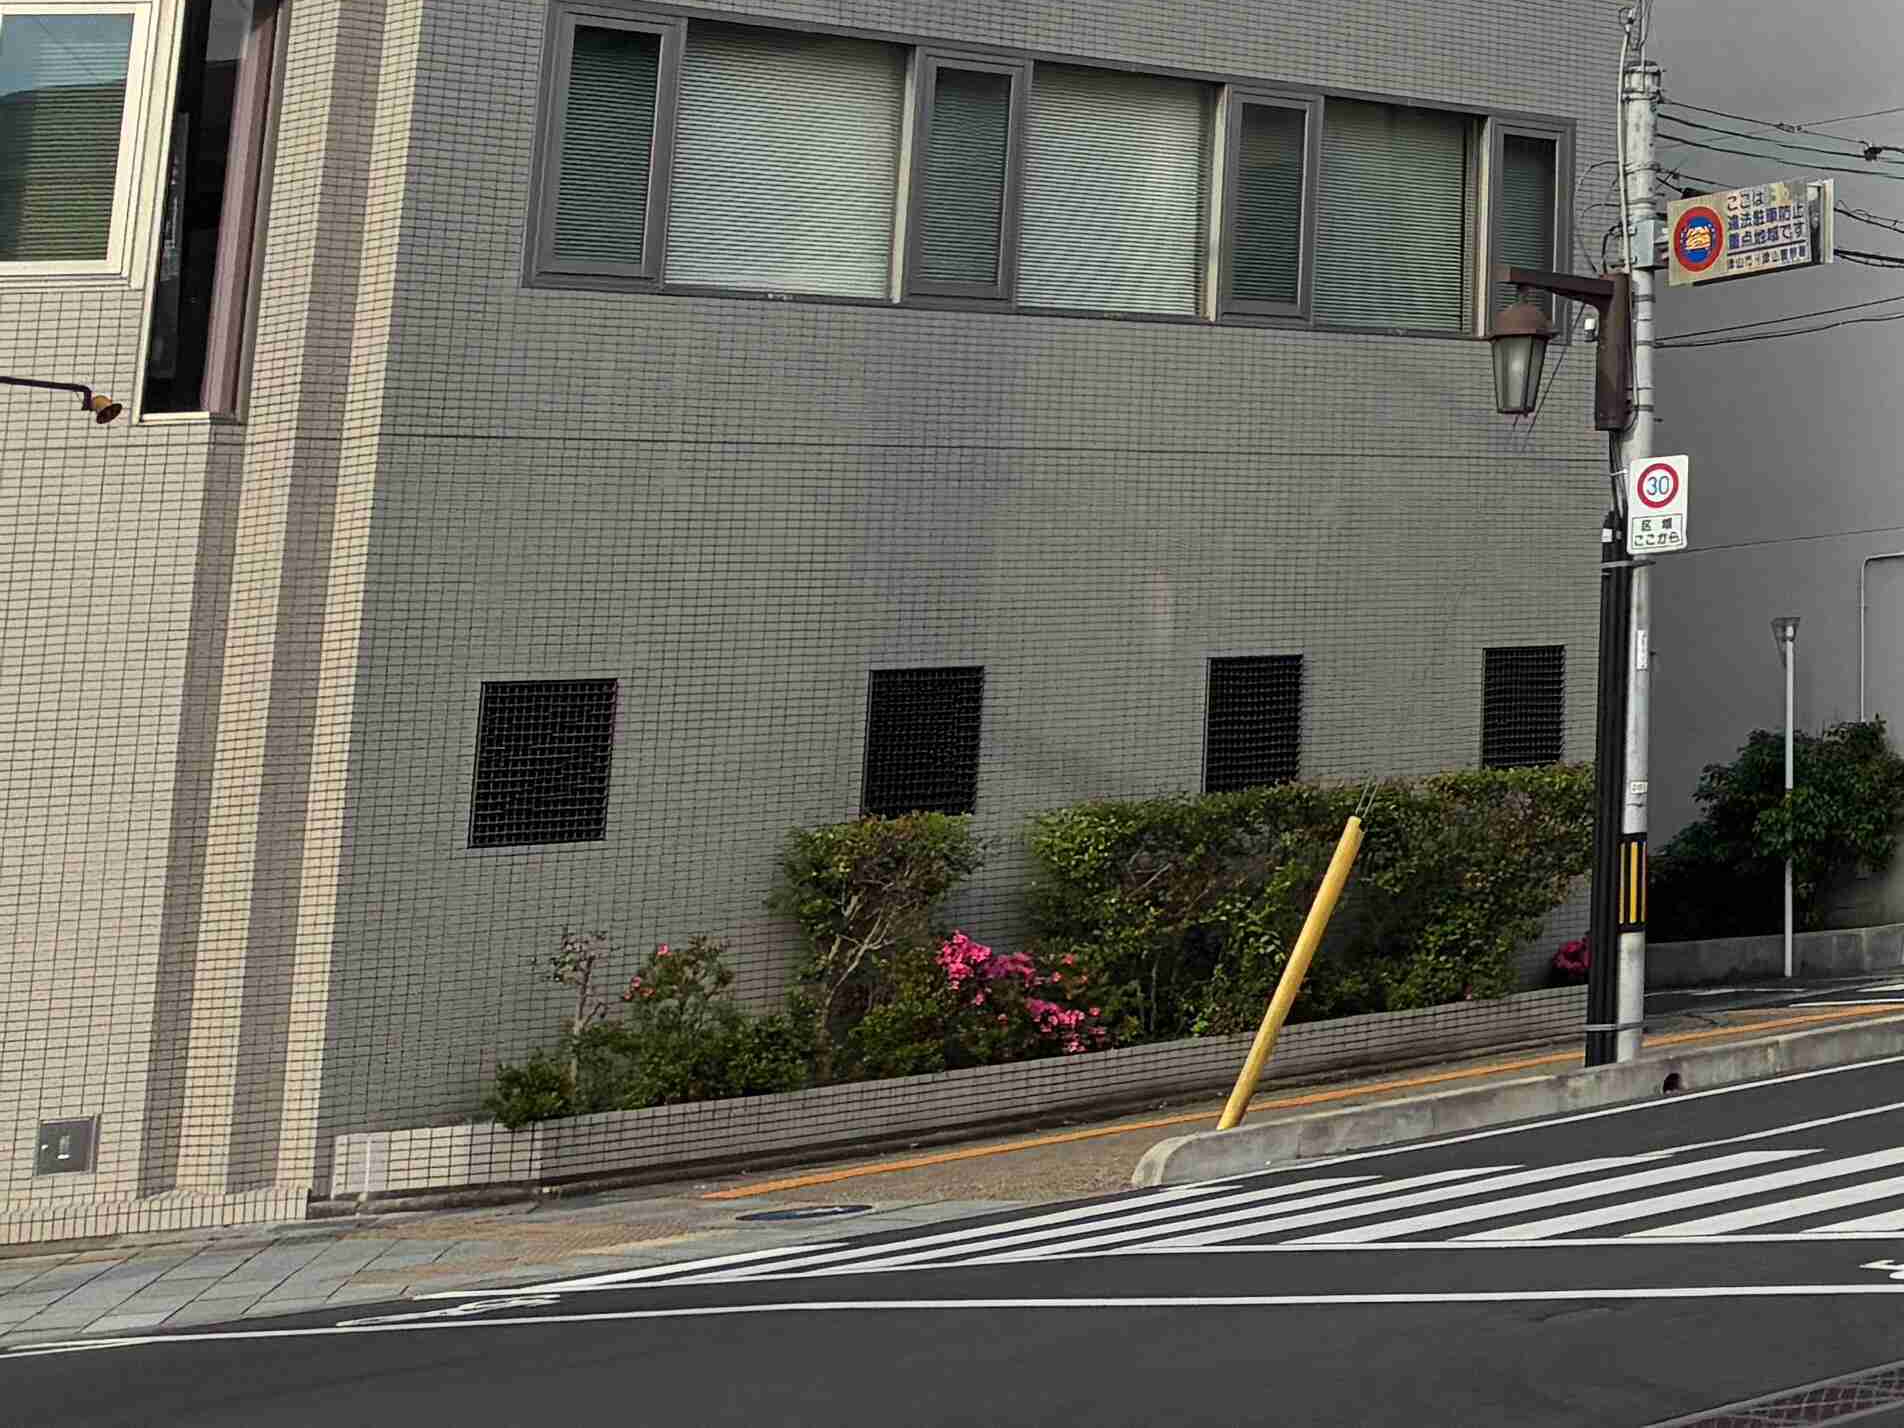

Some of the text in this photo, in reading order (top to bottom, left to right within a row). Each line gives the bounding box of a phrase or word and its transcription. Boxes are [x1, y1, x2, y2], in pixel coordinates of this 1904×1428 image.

[1728, 192, 1762, 211] ここは
[1647, 476, 1670, 495] 30
[1634, 532, 1680, 546] ここから
